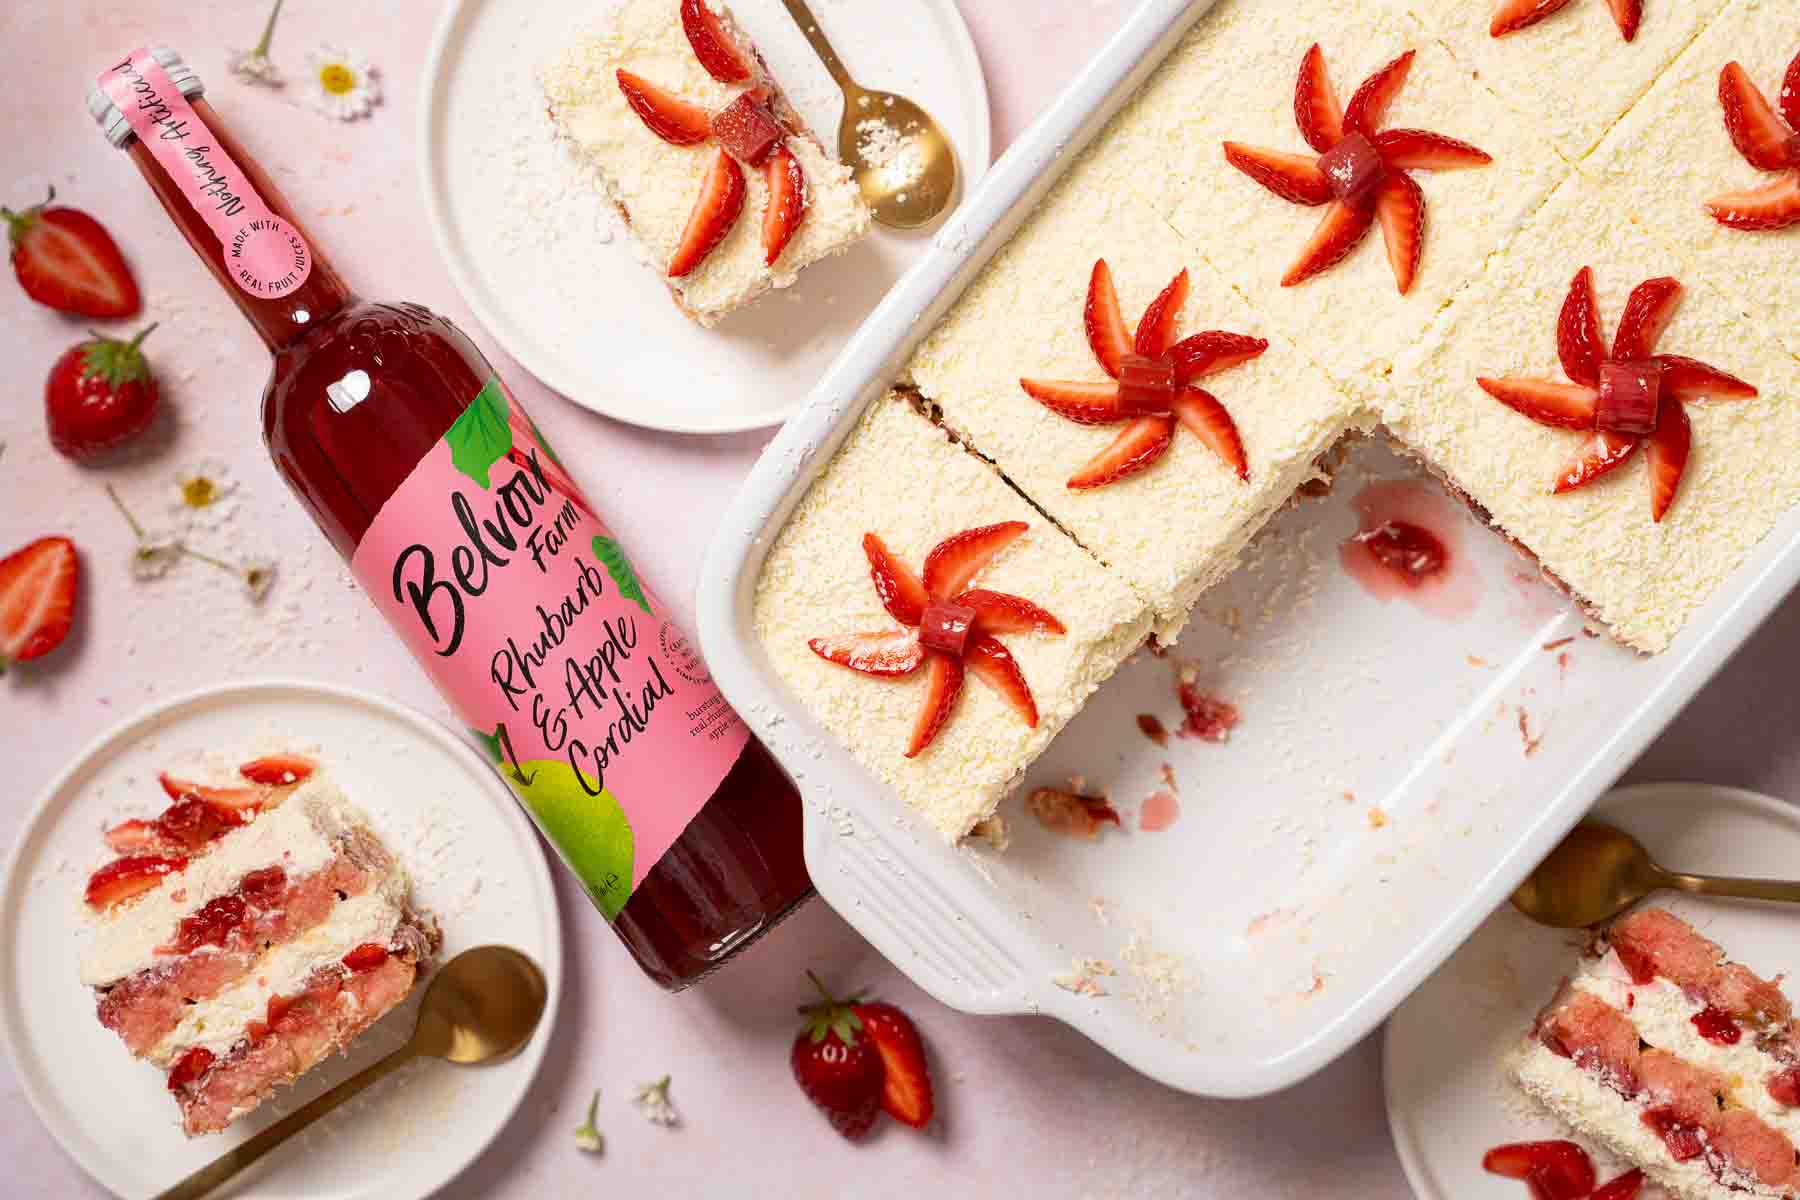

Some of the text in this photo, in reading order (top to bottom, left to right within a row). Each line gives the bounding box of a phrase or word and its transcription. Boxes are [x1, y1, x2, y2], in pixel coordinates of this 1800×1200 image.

[111, 57, 245, 216] Nothing Artificial
[231, 220, 280, 258] MADE WITH
[239, 236, 305, 293] REAL FRUIT JUICES
[392, 447, 552, 657] Belvoir
[525, 500, 581, 573] Farm
[491, 557, 602, 711] Rhubarb
[533, 615, 637, 751] & Apple
[568, 656, 675, 796] Cordial
[690, 717, 707, 737] real
[709, 720, 729, 742] apple
